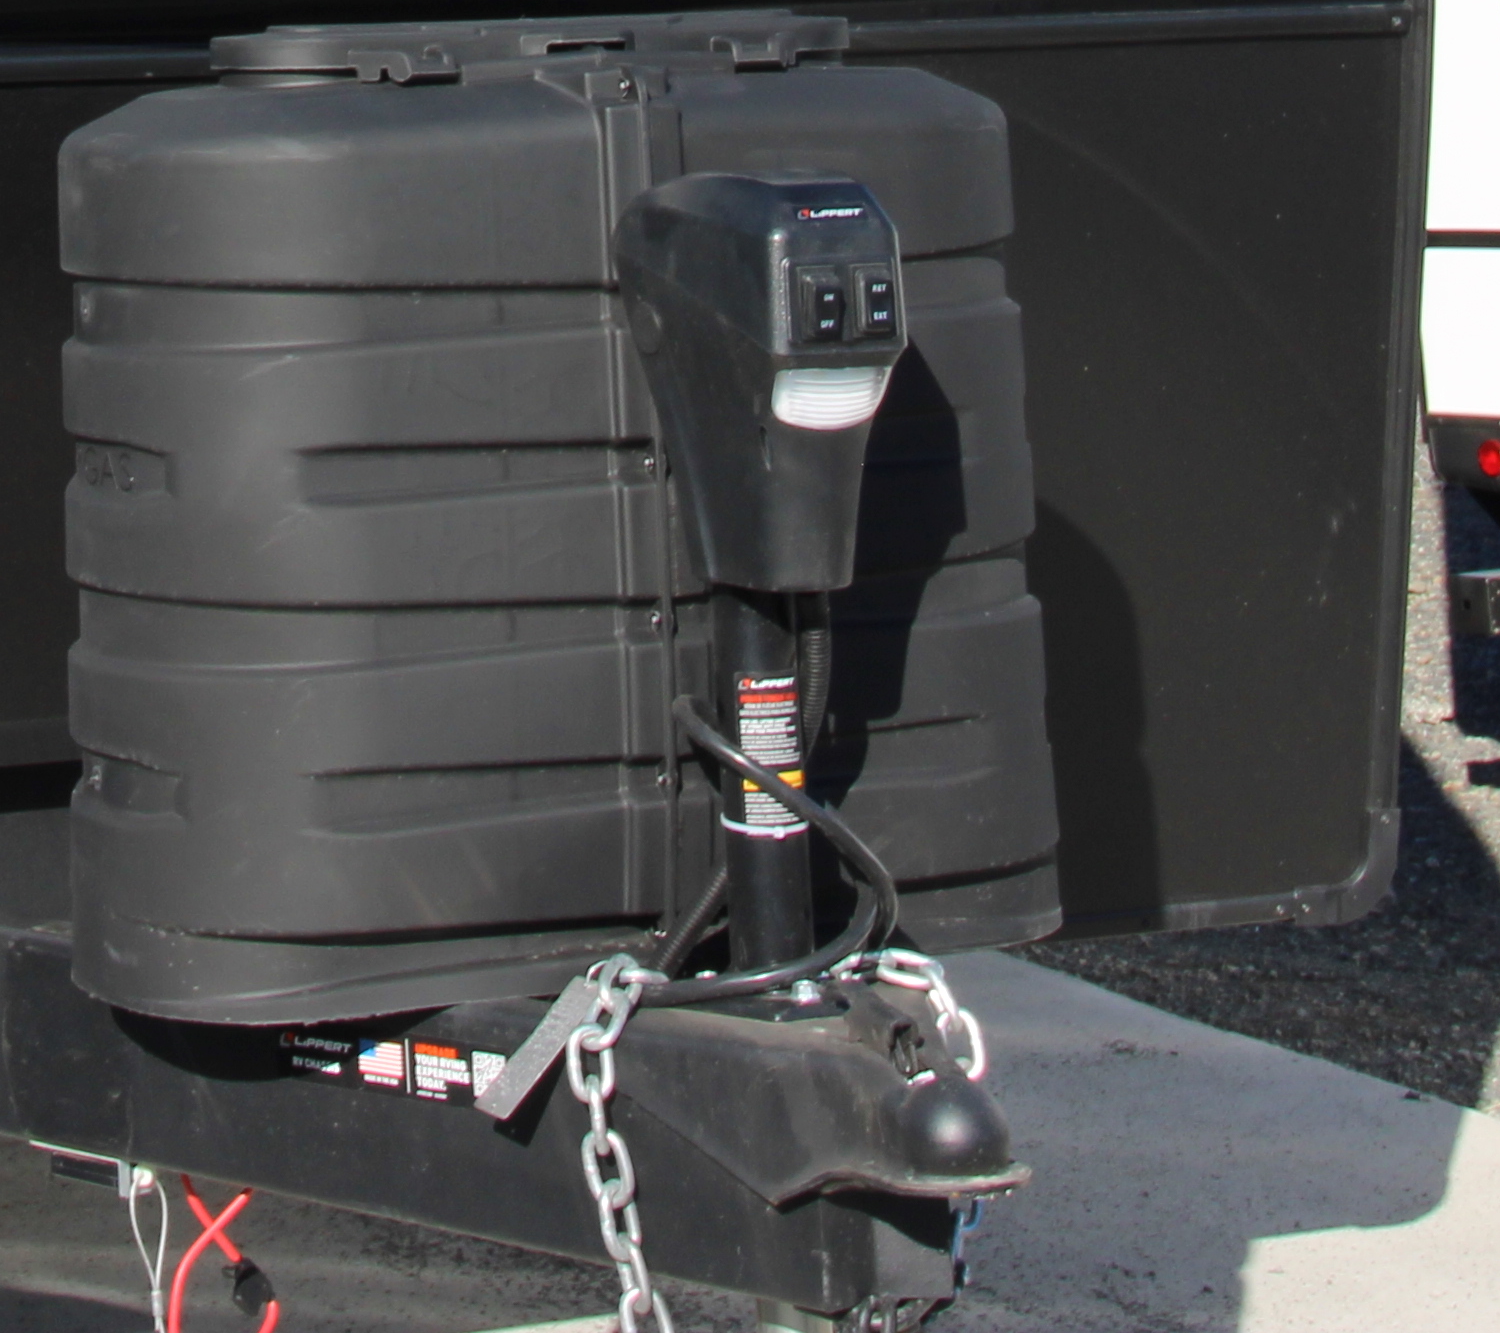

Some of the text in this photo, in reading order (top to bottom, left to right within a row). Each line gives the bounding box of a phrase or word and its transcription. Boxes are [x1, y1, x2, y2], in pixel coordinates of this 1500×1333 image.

[294, 1035, 352, 1053] LIPPERT
[414, 1053, 467, 1072] YOUR RVING
[415, 1064, 471, 1084] EXPERIENCE
[415, 1076, 448, 1091] TODAY.
